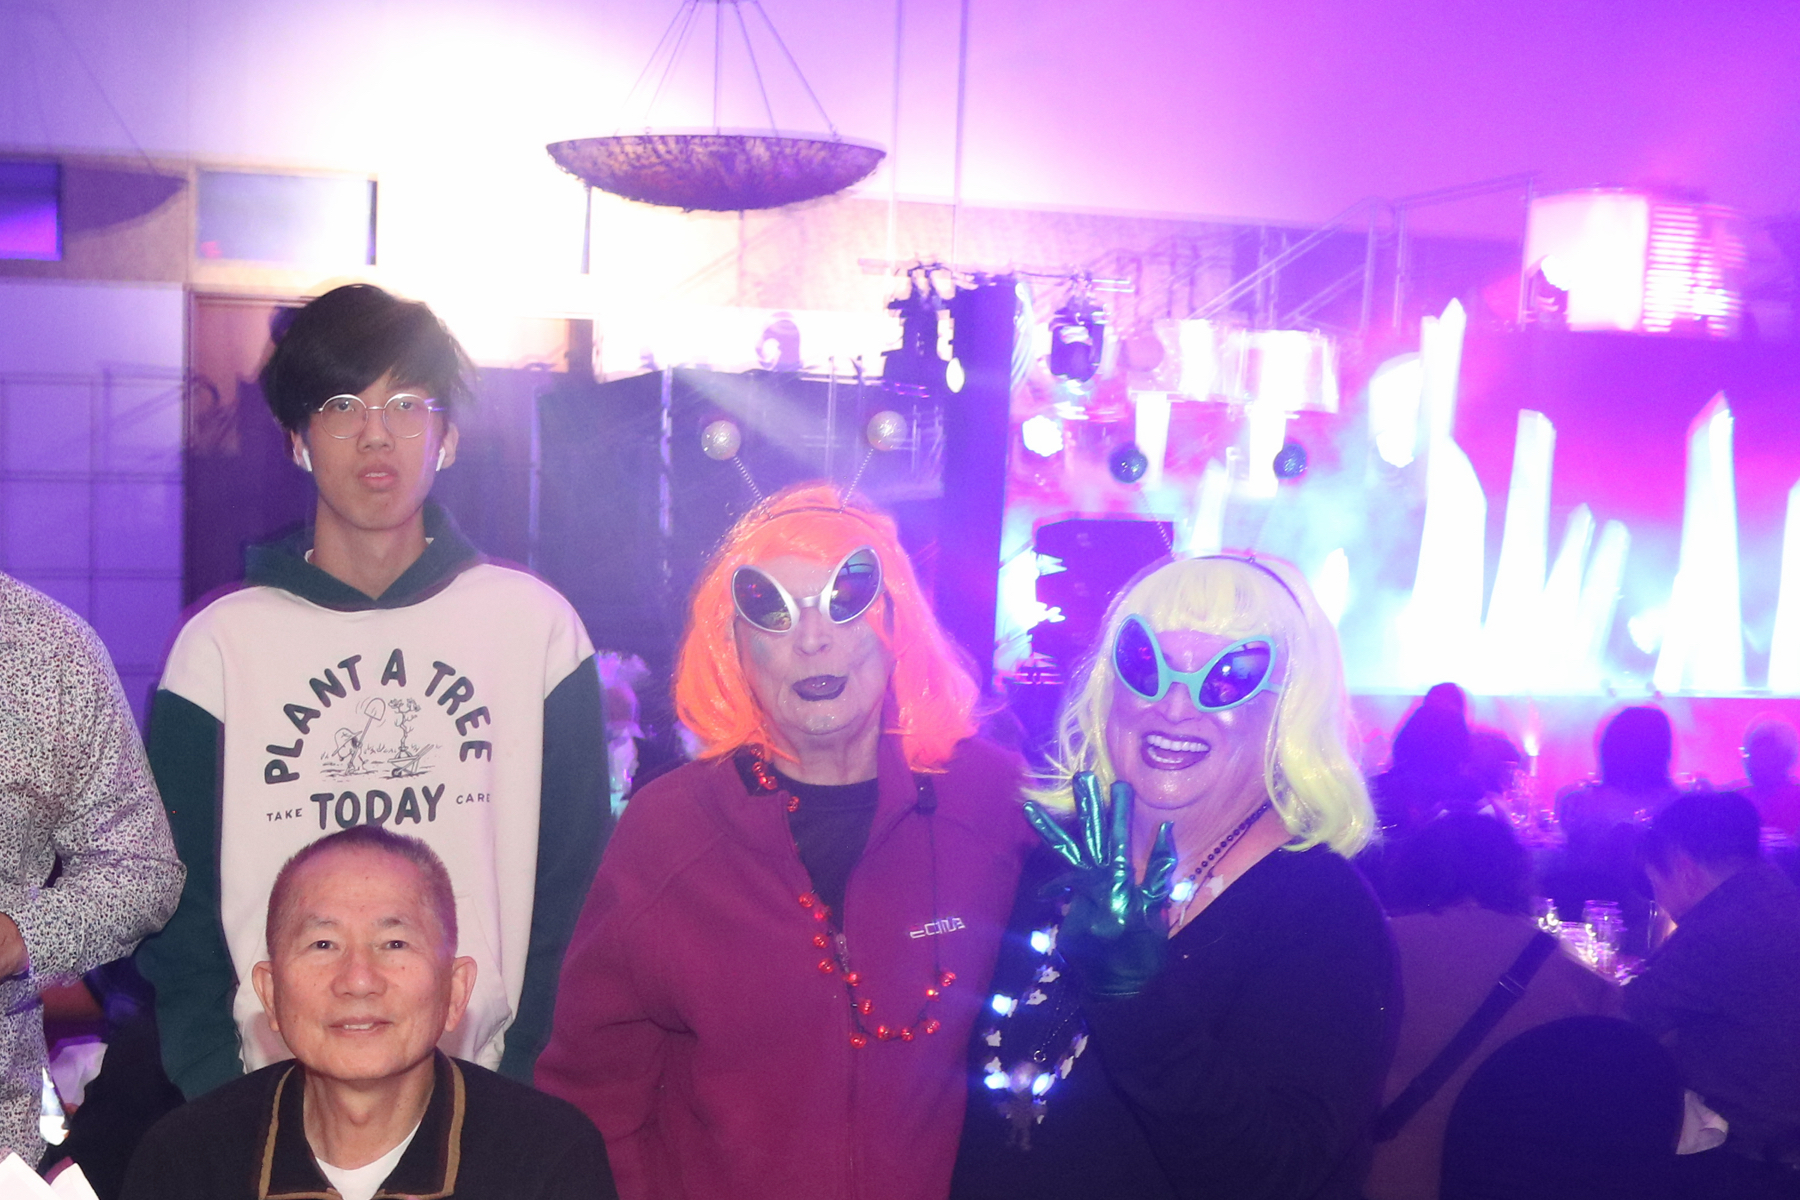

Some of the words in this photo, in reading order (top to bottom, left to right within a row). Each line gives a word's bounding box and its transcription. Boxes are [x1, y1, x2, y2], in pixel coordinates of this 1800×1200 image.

[264, 654, 362, 784] PLANT
[381, 648, 407, 687] A
[424, 660, 493, 762] TREE
[266, 808, 303, 822] TAKE
[455, 793, 491, 805] CARE
[310, 783, 446, 830] TODAY
